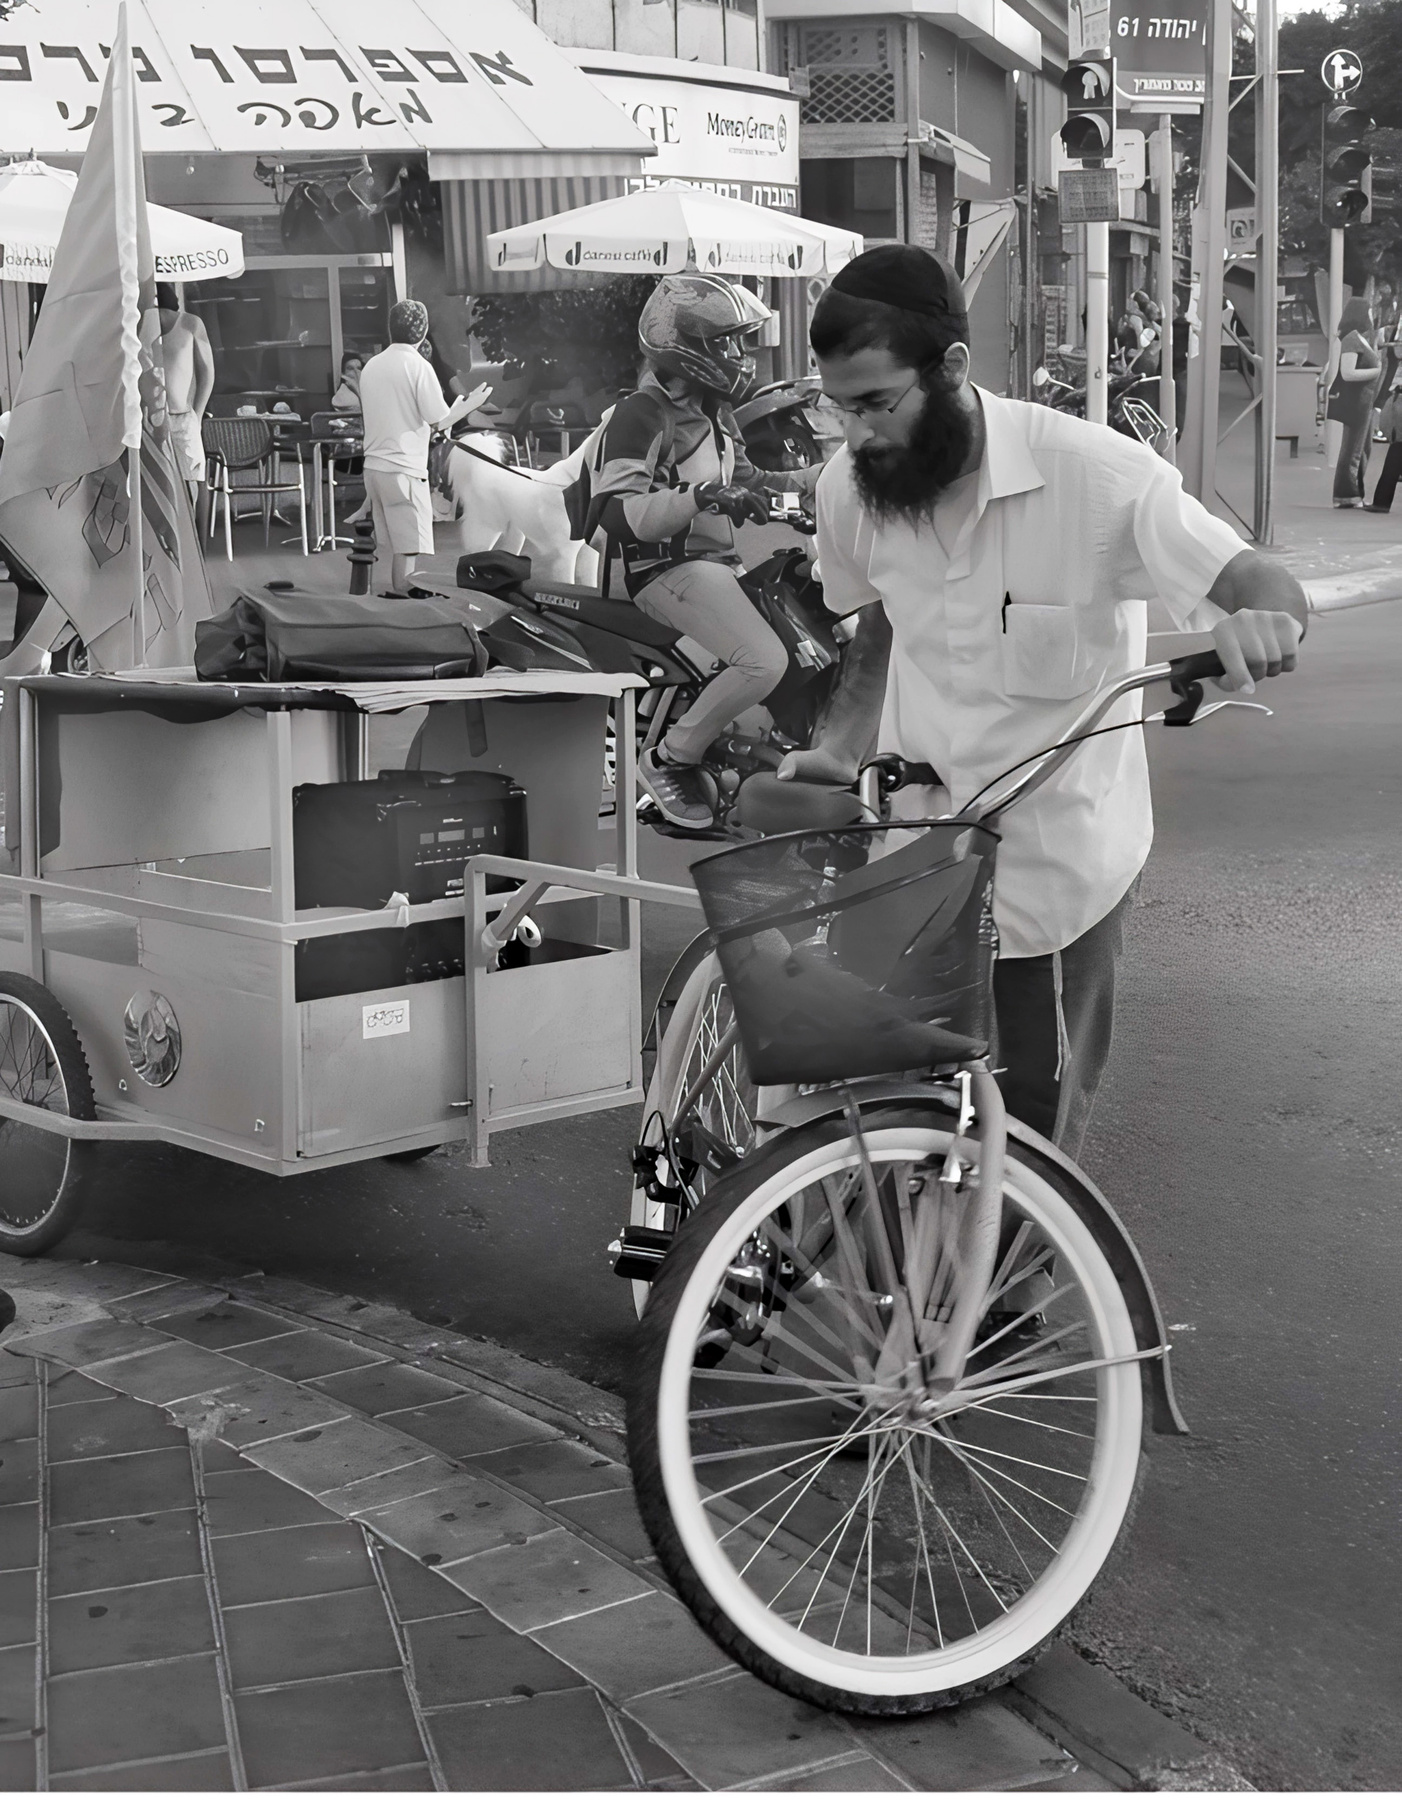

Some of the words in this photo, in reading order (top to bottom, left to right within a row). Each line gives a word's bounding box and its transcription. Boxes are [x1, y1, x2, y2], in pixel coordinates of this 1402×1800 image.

[1117, 16, 1140, 37] 61
[1147, 18, 1197, 39] יהודה
[190, 43, 534, 86] אספרסו
[236, 88, 433, 130] מאפה
